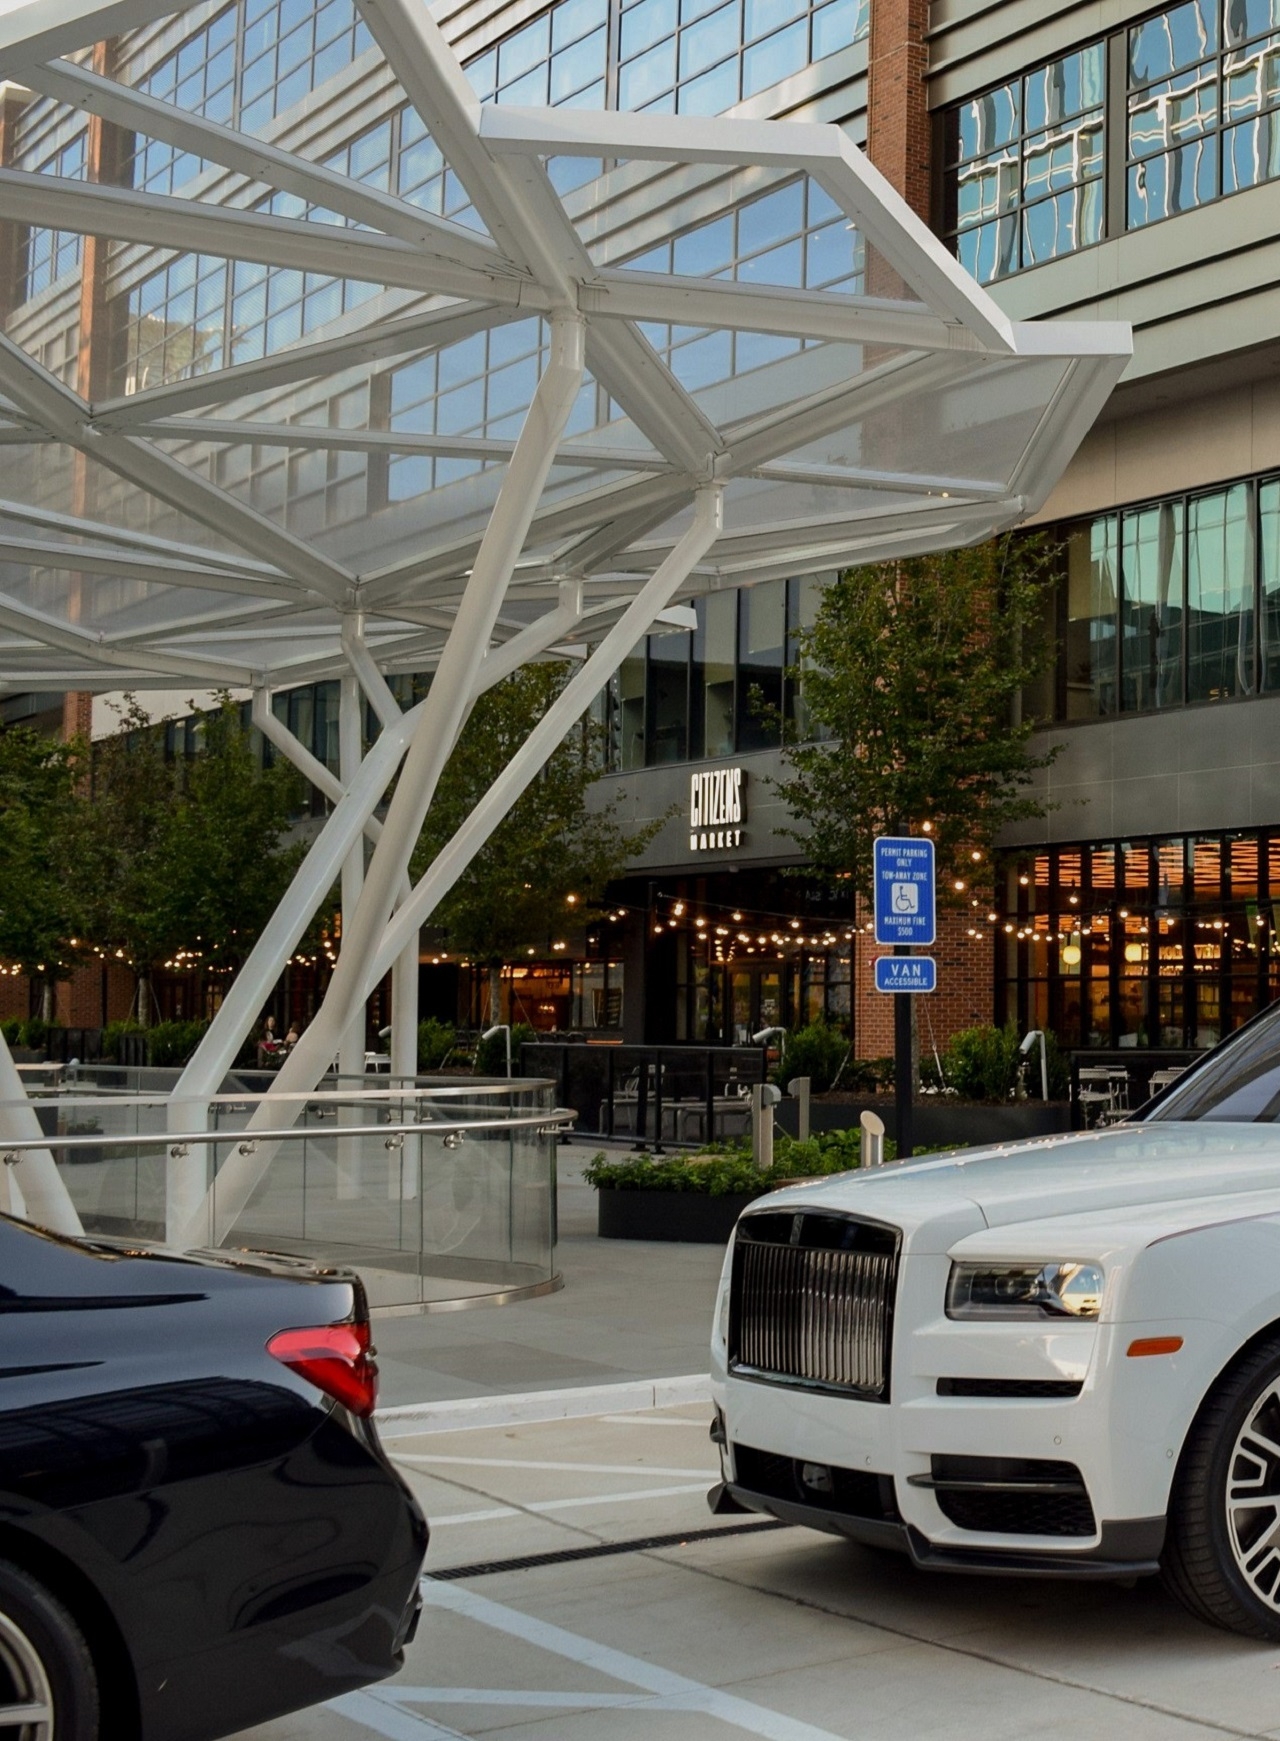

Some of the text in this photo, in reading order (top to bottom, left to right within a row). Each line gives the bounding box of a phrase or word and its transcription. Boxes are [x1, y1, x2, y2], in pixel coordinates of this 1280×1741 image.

[691, 767, 741, 827] CITIZENS
[690, 829, 741, 851] MARKET
[881, 847, 928, 858] PERMIT PARKING
[896, 858, 912, 867] ONLY
[882, 870, 928, 881] TOW-AWAY ZONE
[884, 916, 926, 926] MAXIMUM FINE
[897, 926, 913, 937] $500
[891, 963, 921, 977] VAN
[884, 977, 928, 986] ACCESSIBLE
